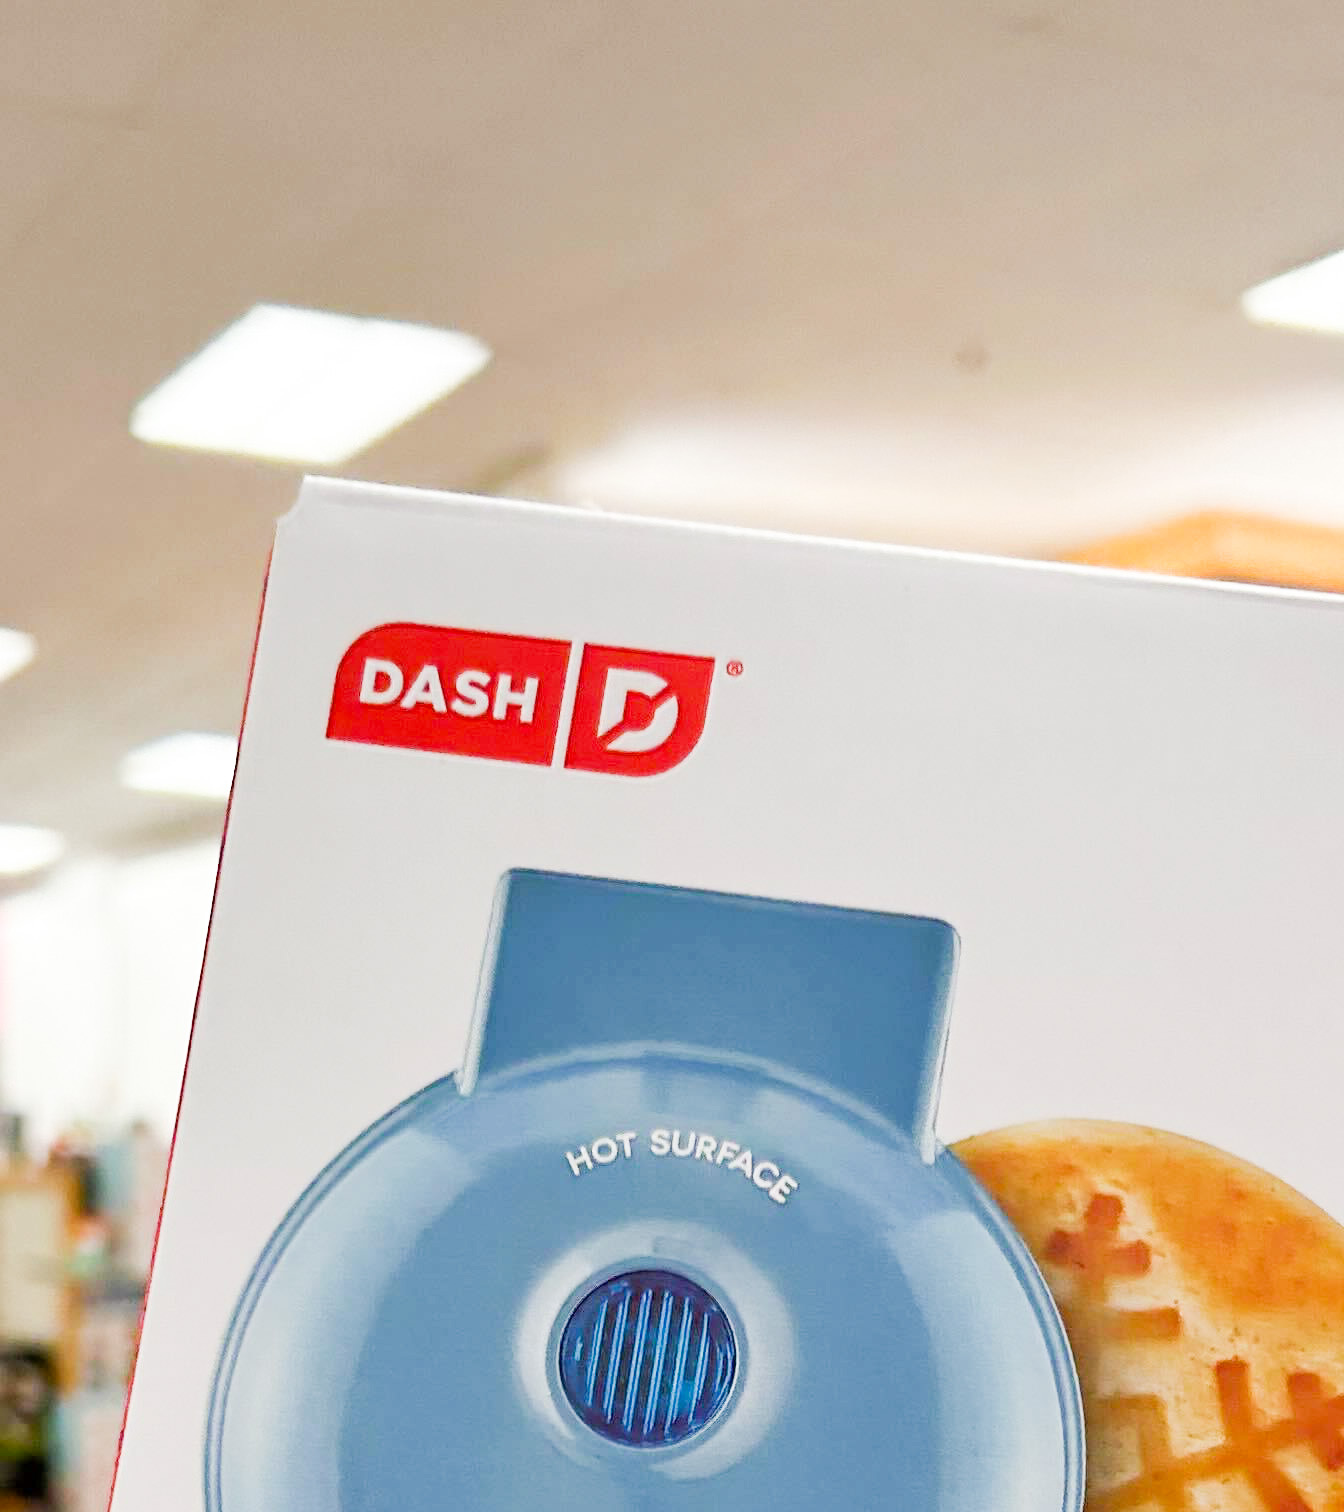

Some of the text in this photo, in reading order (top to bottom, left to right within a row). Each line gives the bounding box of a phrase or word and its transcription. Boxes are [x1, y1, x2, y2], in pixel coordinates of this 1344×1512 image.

[358, 657, 539, 725] DASH
[565, 1128, 800, 1205] HOT SURFACE
